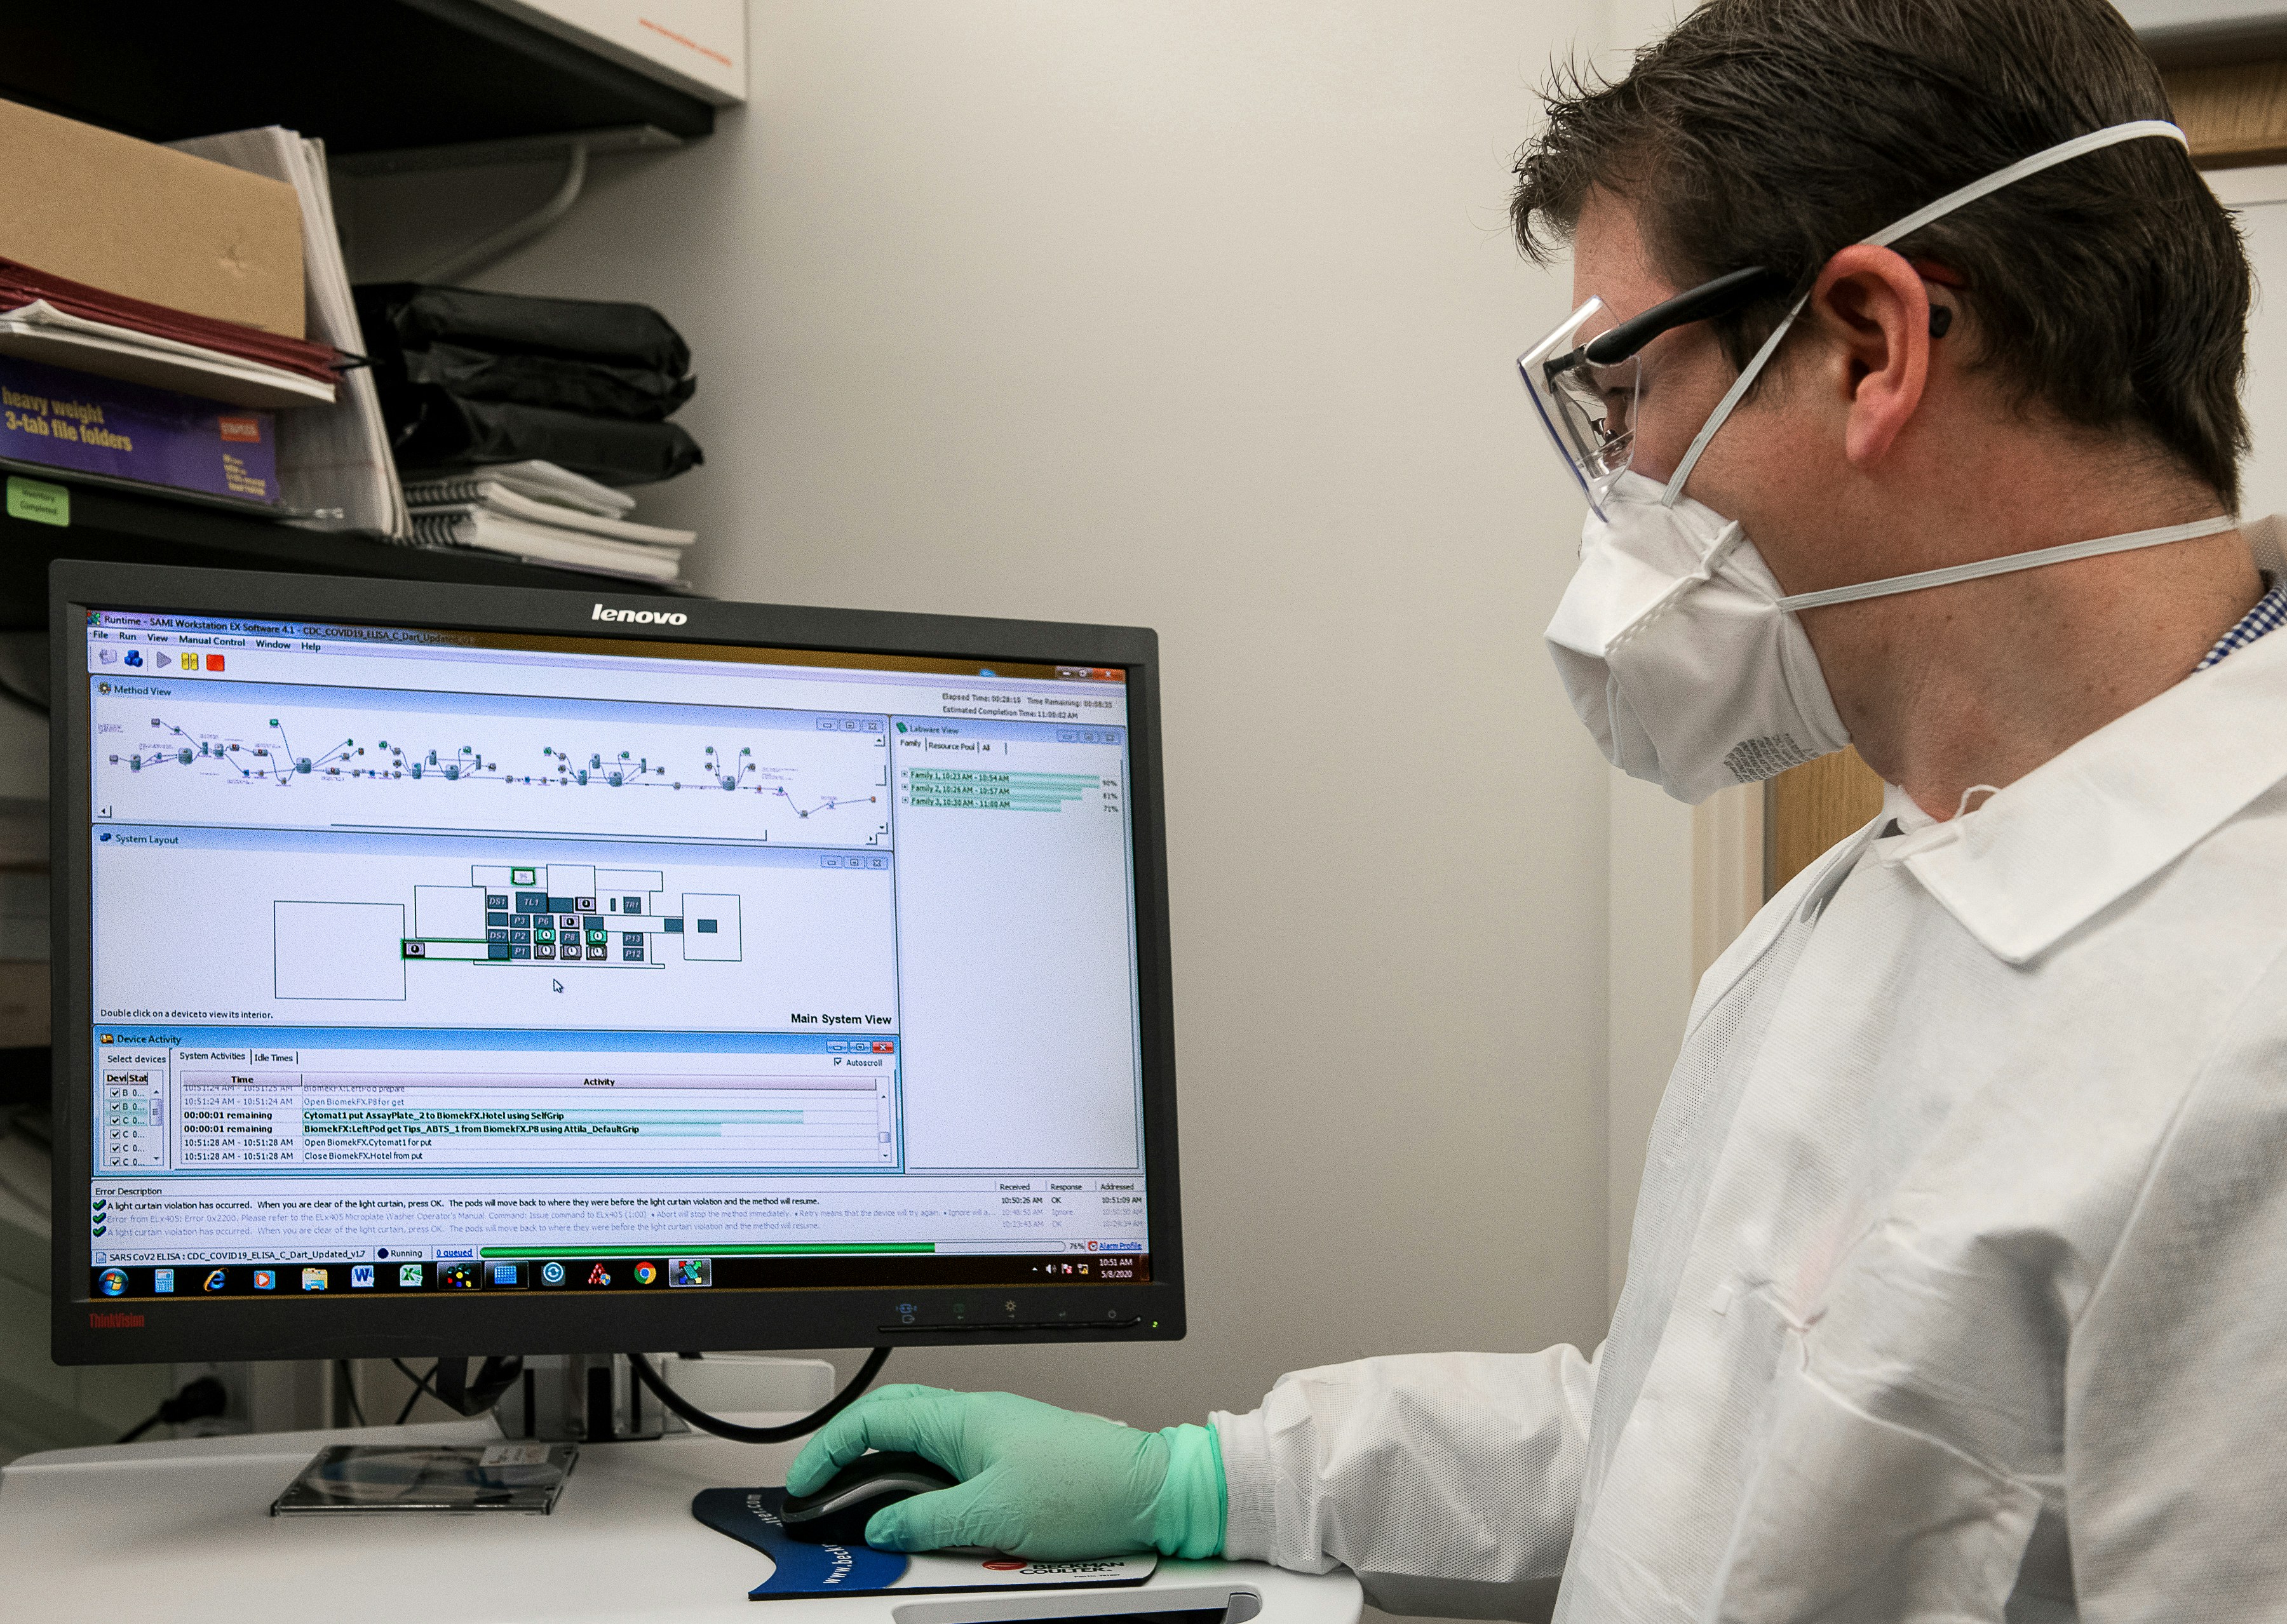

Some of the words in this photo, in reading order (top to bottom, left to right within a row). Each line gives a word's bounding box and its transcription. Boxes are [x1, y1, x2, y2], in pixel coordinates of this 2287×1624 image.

[1, 386, 48, 417] heavy
[51, 399, 105, 425] weight
[5, 410, 50, 436] 3-tab
[51, 418, 78, 442] file
[79, 424, 133, 452] folders
[591, 603, 687, 626] lenovo
[104, 615, 141, 626] Runtime
[150, 618, 173, 627] SAMI
[175, 619, 227, 630] Workstation
[229, 622, 241, 631] EX
[242, 623, 280, 633] Software
[281, 626, 295, 634] 4.1
[93, 631, 108, 639] File
[119, 632, 137, 640] Run
[147, 633, 168, 643] View
[179, 635, 211, 645] Manual
[213, 637, 246, 647] Control
[255, 639, 291, 649] Window
[301, 642, 321, 653] Help
[114, 685, 149, 695] Method
[150, 687, 172, 696] View
[943, 706, 977, 715] Estimated
[978, 708, 1018, 717] Completion
[910, 724, 940, 733] Labware
[941, 726, 959, 734] View
[900, 739, 921, 748] Family
[928, 742, 959, 750] Resource
[116, 834, 147, 844] System
[149, 836, 179, 845] Layout
[100, 1009, 131, 1017] Double
[133, 1009, 151, 1017] click
[172, 1010, 198, 1018] device
[241, 1010, 274, 1019] interior.
[791, 1014, 818, 1023] Main
[821, 1014, 862, 1026] System
[865, 1015, 892, 1024] View
[149, 1035, 182, 1045] Activity
[107, 1055, 132, 1063] Select
[135, 1055, 166, 1063] devices
[180, 1052, 208, 1060] System
[211, 1052, 245, 1060] Activities
[255, 1054, 269, 1062] Idle
[271, 1054, 293, 1062] Times
[107, 1074, 126, 1082] Devi
[583, 1078, 615, 1087] Activity
[227, 1111, 273, 1120] remaining
[304, 1111, 347, 1121] Cytomat1
[349, 1113, 363, 1121] put
[365, 1111, 424, 1121] AssayPlate_2
[436, 1111, 506, 1120] BiomekFX.Hotel
[507, 1112, 530, 1121] using
[531, 1111, 564, 1121] SelfGrip
[304, 1125, 386, 1133] BiomekFX:LeftPod
[386, 1126, 401, 1134] get
[403, 1125, 460, 1134] Tips_ABTS_1
[483, 1125, 539, 1133] BiomekFX.P8
[540, 1125, 562, 1134] using
[563, 1125, 639, 1134] Attila_DefaultGrip
[304, 1139, 326, 1148] Open
[327, 1138, 407, 1147] BiomekFX.Cytomat1
[420, 1139, 431, 1148] put
[411, 1153, 422, 1161] put
[118, 1187, 162, 1196] Description
[1050, 1183, 1083, 1191] Response
[116, 1202, 132, 1211] light
[135, 1202, 162, 1210] curtain
[165, 1202, 198, 1210] violation
[199, 1201, 213, 1209] has
[215, 1201, 252, 1209] occurred.
[257, 1200, 281, 1209] When
[283, 1202, 297, 1210] you
[314, 1200, 332, 1208] clear
[334, 1200, 344, 1208] of
[345, 1200, 357, 1208] the
[359, 1200, 375, 1209] light
[377, 1200, 406, 1209] curtain,
[408, 1200, 429, 1209] press
[431, 1199, 445, 1207] OK.
[449, 1199, 463, 1207] The
[465, 1199, 483, 1209] pods
[519, 1198, 536, 1207] back
[548, 1198, 571, 1207] where
[572, 1198, 589, 1207] they
[611, 1198, 635, 1206] before
[650, 1198, 666, 1207] light
[693, 1197, 722, 1205] violation
[724, 1197, 738, 1205] and
[1099, 1242, 1119, 1251] Alarm
[1119, 1242, 1142, 1250] Profile
[109, 1253, 132, 1261] SARS
[133, 1253, 155, 1261] CoV2
[157, 1252, 180, 1261] ELISA
[391, 1249, 422, 1258] Running
[443, 1249, 473, 1258] queued
[1101, 1270, 1133, 1278] 5/8/2020
[89, 1313, 145, 1328] ThinkVision
